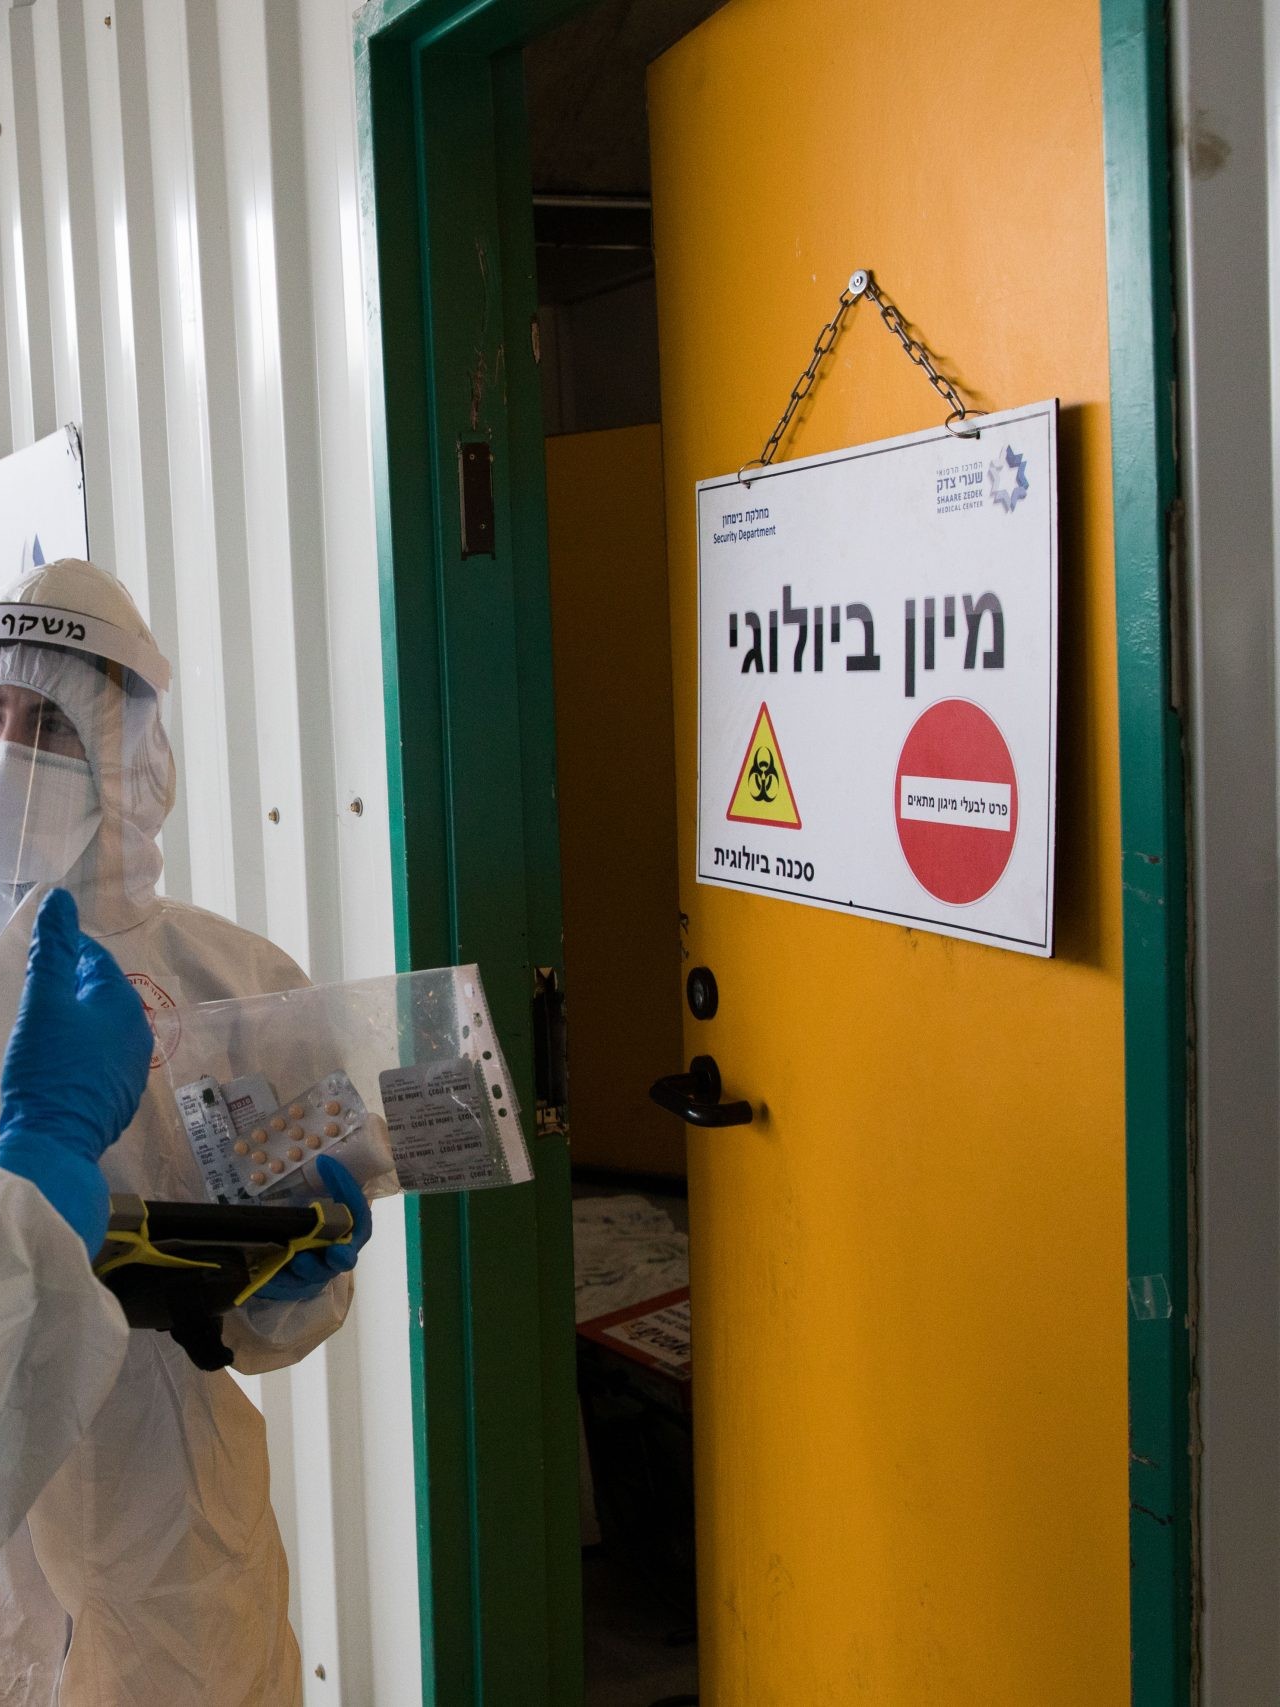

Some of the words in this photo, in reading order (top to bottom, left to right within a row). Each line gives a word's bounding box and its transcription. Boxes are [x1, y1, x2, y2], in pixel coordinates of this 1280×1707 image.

[936, 476, 956, 493] צדק
[959, 471, 983, 487] שערי
[936, 492, 962, 505] SHAARE
[963, 489, 983, 500] ZEDEK
[936, 505, 961, 514] MEDICAL
[962, 500, 983, 511] CENTER
[722, 512, 743, 528] ביטחון
[745, 508, 770, 524] מחלקת
[713, 530, 737, 544] Security
[738, 525, 776, 541] Department
[1, 613, 86, 642] משקף
[728, 585, 881, 674] ביולוגי
[904, 591, 1005, 698] מיון
[907, 794, 935, 808] מתאים
[937, 797, 957, 812] מיגון
[960, 796, 986, 814] לבעלי
[988, 802, 1008, 816] פרט
[713, 845, 771, 874] ביולוגית
[775, 857, 815, 882] סכנה
